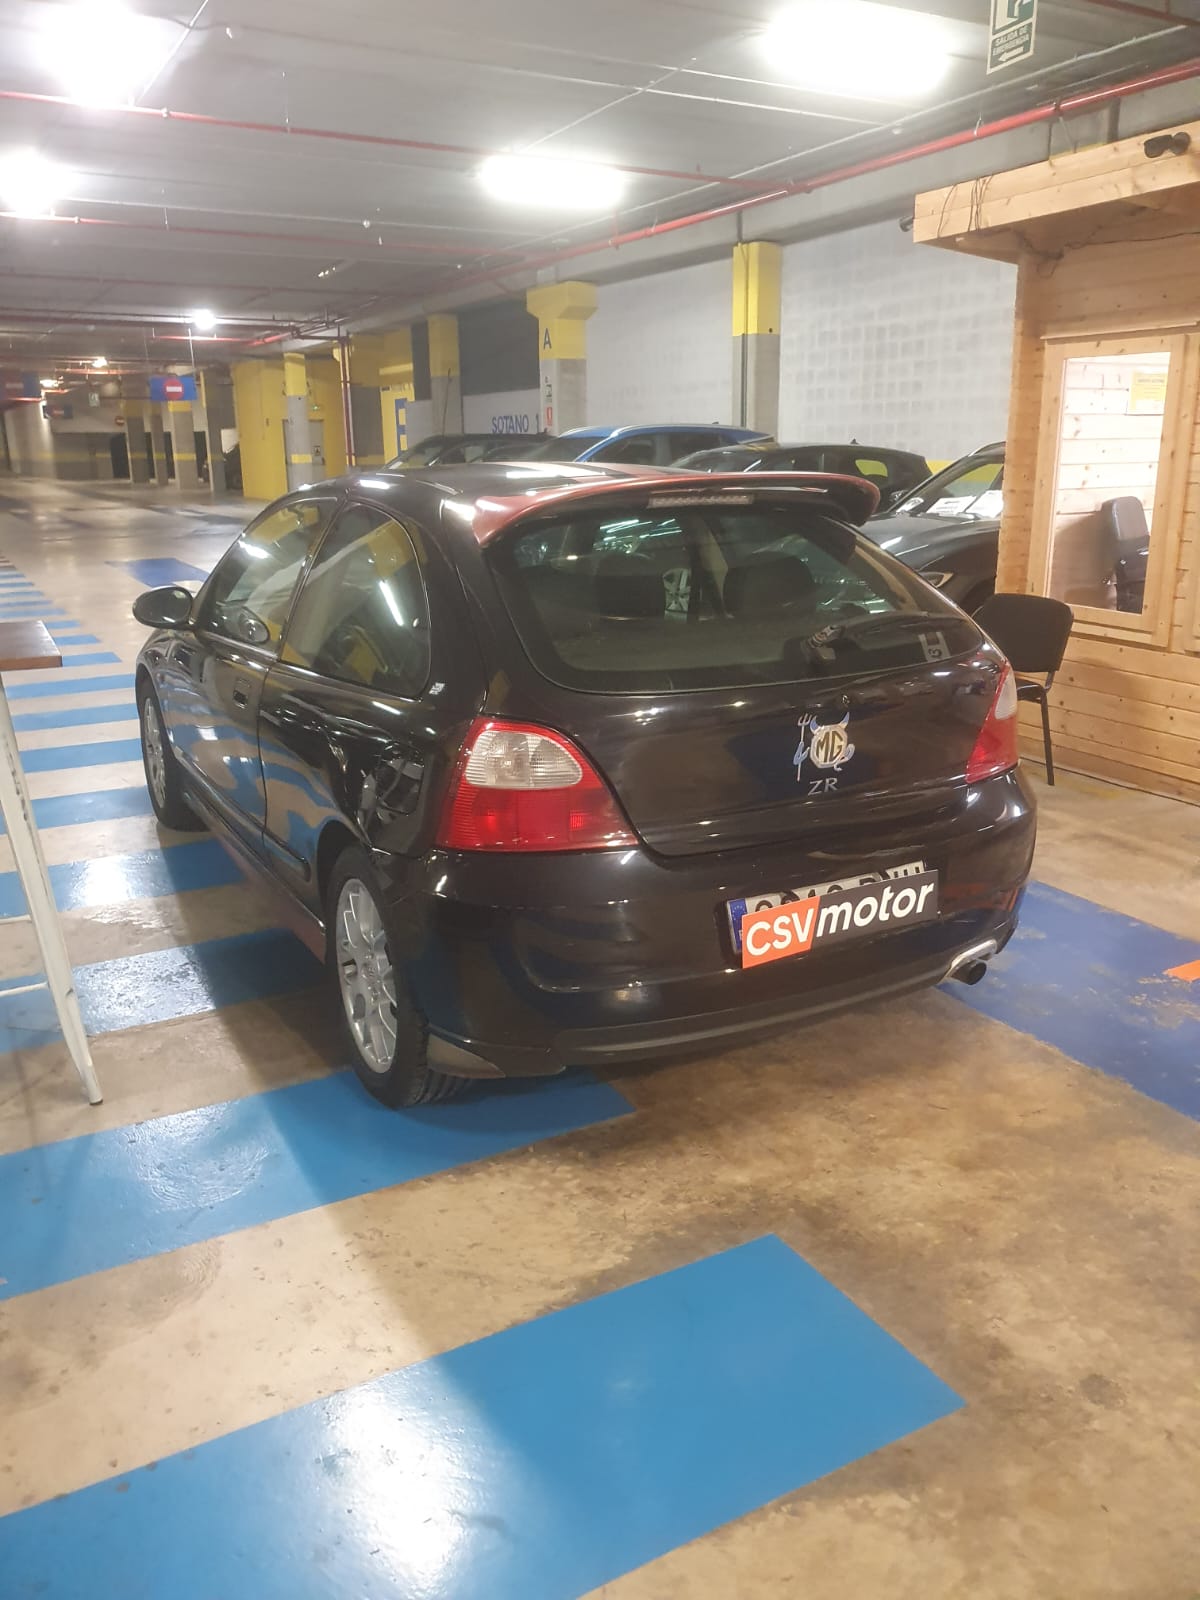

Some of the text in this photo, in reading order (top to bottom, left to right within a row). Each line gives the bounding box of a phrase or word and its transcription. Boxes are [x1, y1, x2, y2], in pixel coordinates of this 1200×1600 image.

[543, 327, 552, 350] A
[816, 730, 844, 763] MG
[807, 777, 838, 796] ZR
